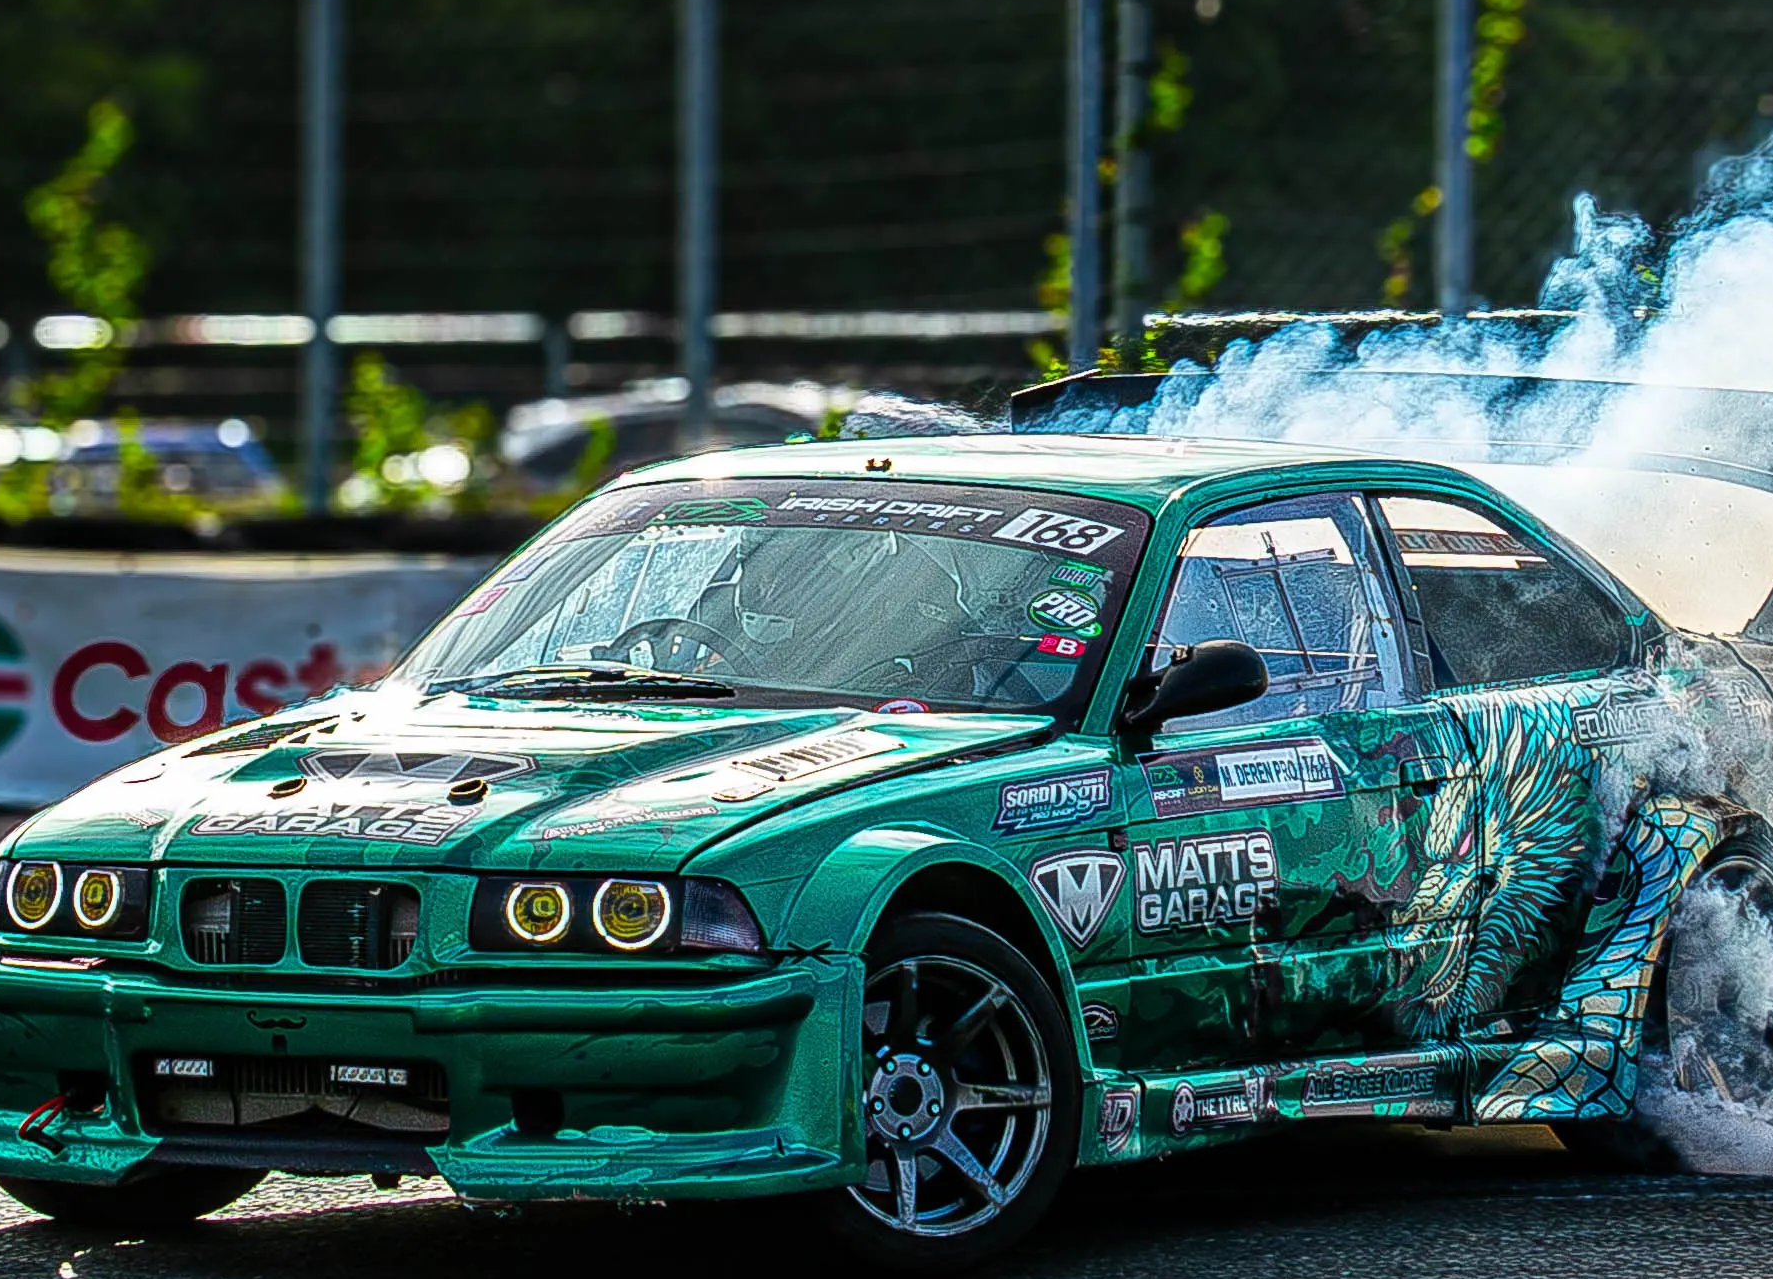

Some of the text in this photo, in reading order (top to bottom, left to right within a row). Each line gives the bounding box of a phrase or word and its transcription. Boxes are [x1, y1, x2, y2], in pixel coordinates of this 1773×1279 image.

[813, 513, 974, 533] SERIES
[880, 500, 1002, 522] DRIFT
[1014, 513, 1109, 549] 168
[1031, 592, 1097, 627] PRO
[51, 639, 390, 744] Cast
[1234, 760, 1275, 786] DEREN
[1272, 759, 1300, 783] PRO
[1301, 753, 1331, 783] 168
[199, 815, 456, 841] GARAGE
[246, 801, 476, 824] ATTS
[1137, 837, 1274, 892] MATTS
[1140, 879, 1276, 928] GARAGE
[1195, 1097, 1217, 1117] THE
[1217, 1093, 1248, 1116] TYRE
